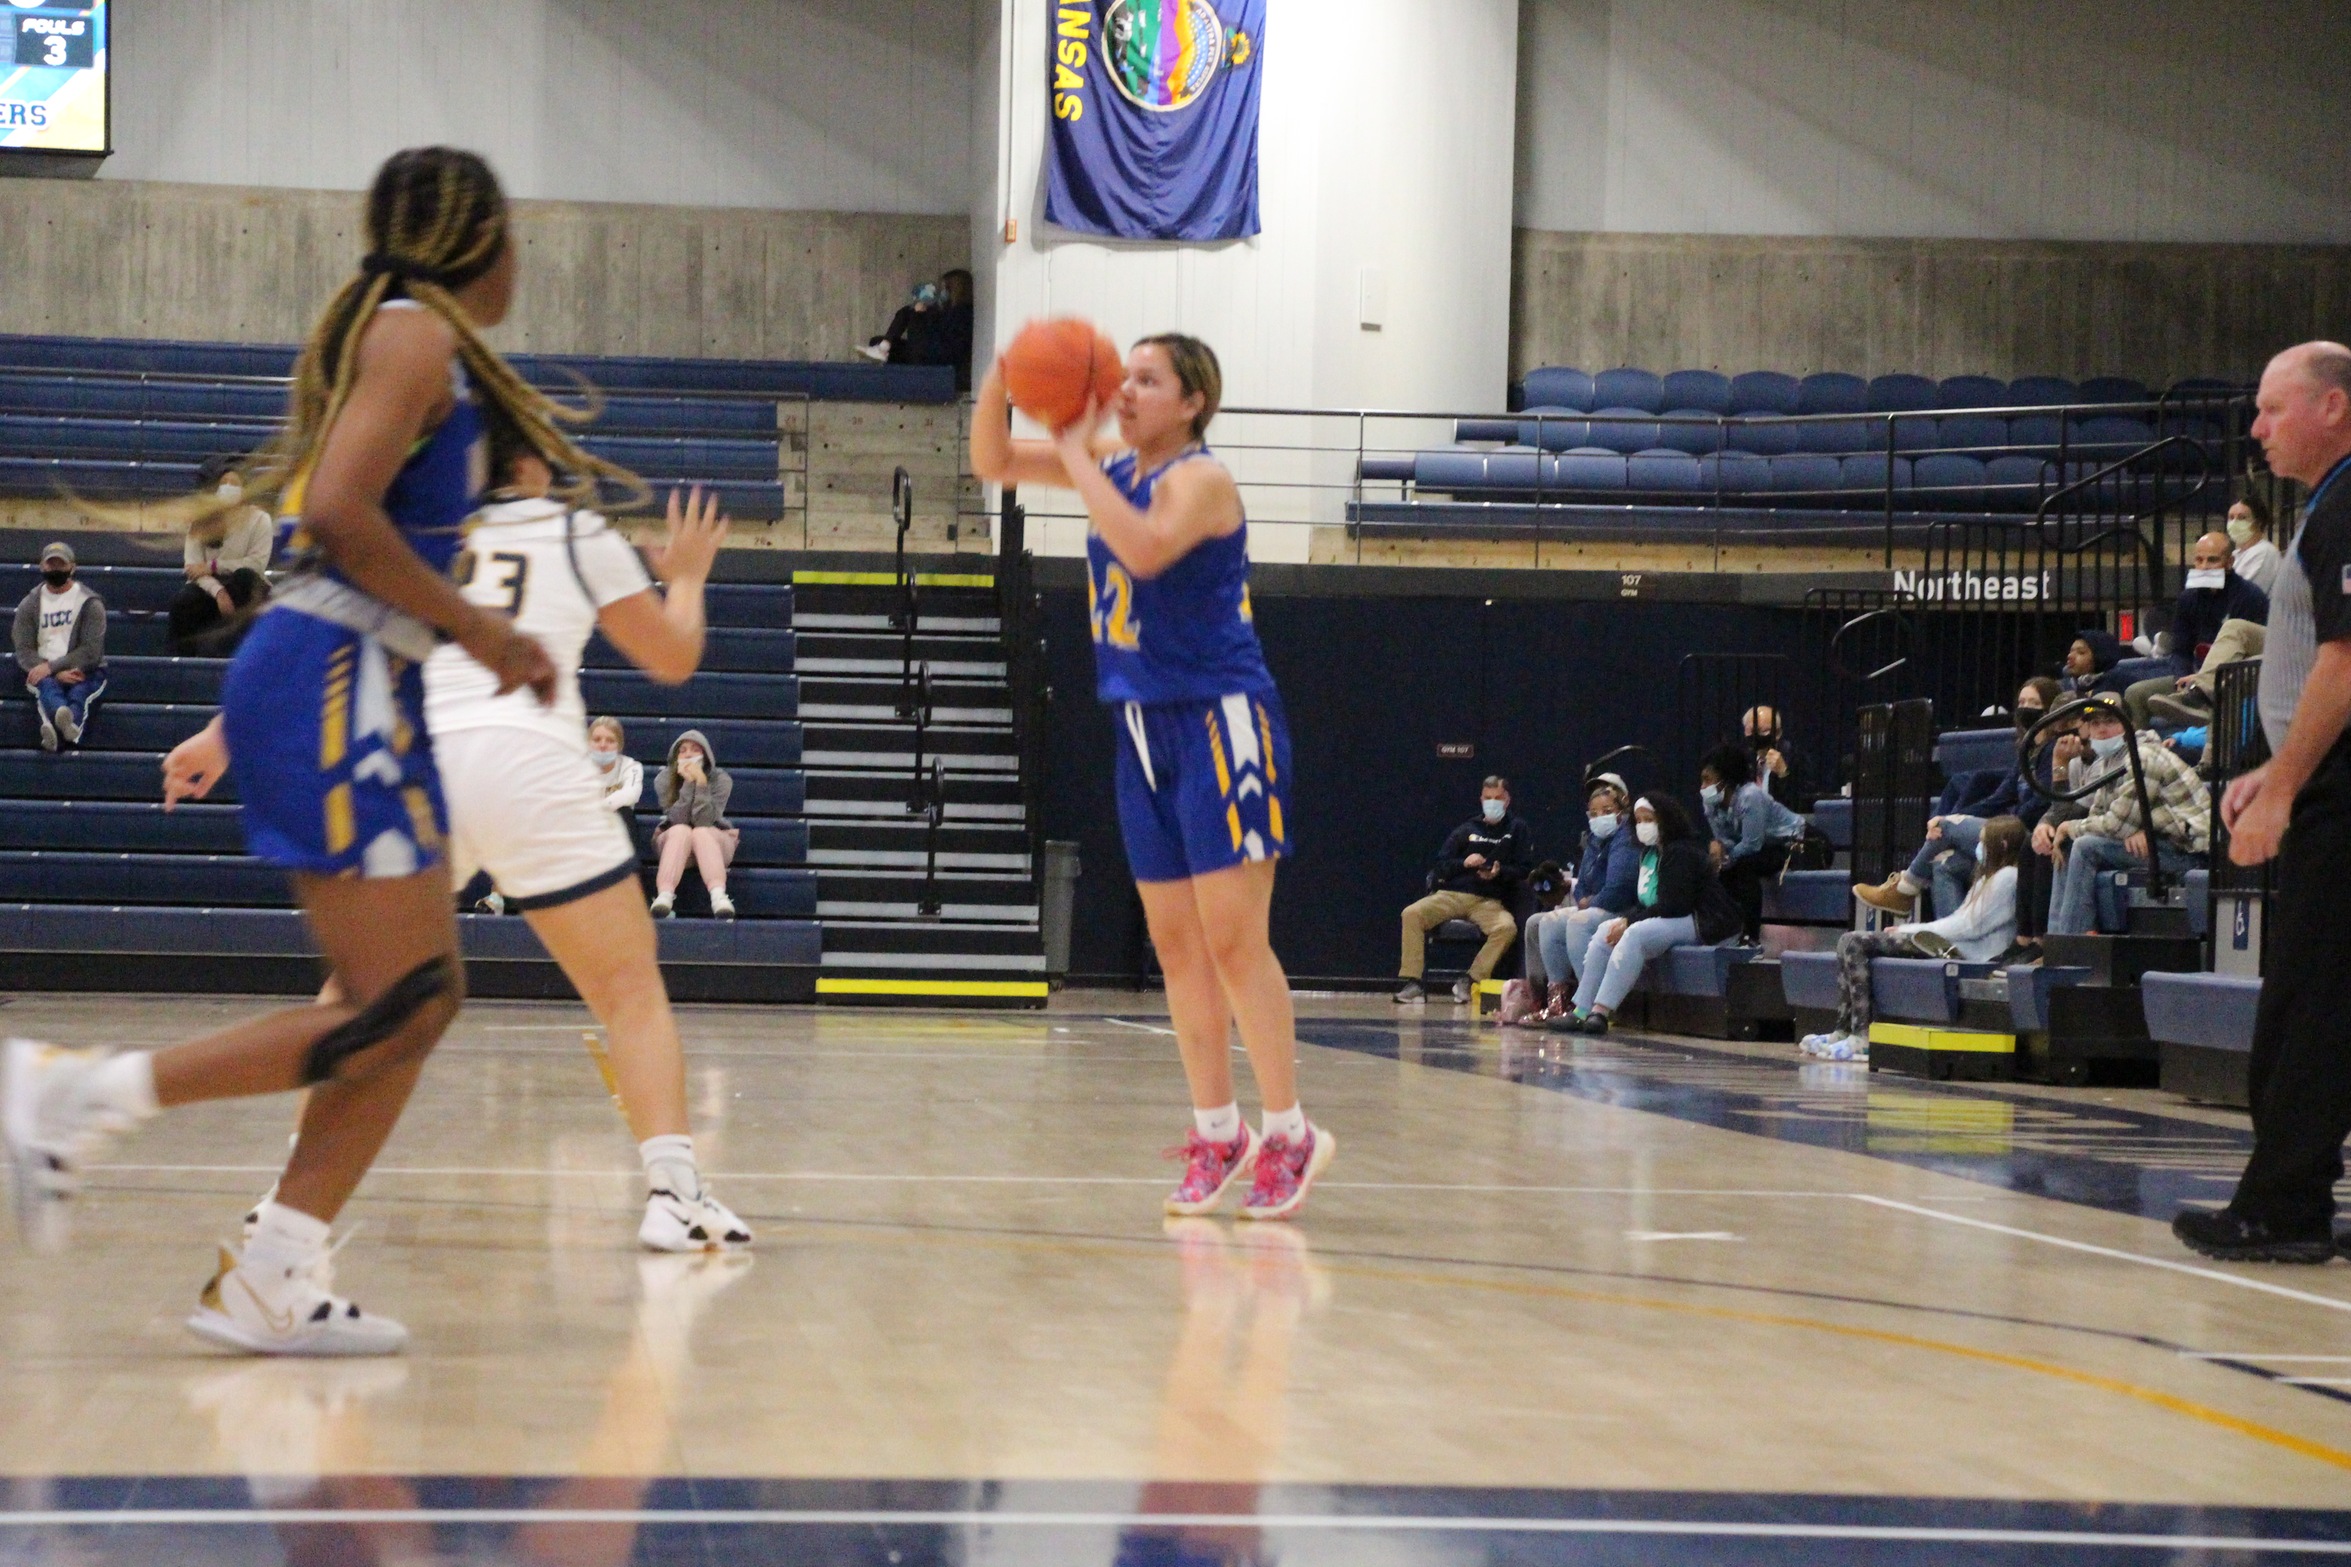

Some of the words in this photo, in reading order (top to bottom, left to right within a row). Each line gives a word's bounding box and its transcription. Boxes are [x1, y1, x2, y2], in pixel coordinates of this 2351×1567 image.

[22, 18, 85, 35] FOULS
[44, 36, 67, 65] 3
[1054, 0, 1092, 121] NSAS
[1621, 574, 1642, 586] 107
[1893, 570, 2050, 601] Northeast
[1620, 588, 1638, 597] GYM
[1441, 746, 1456, 754] GYM
